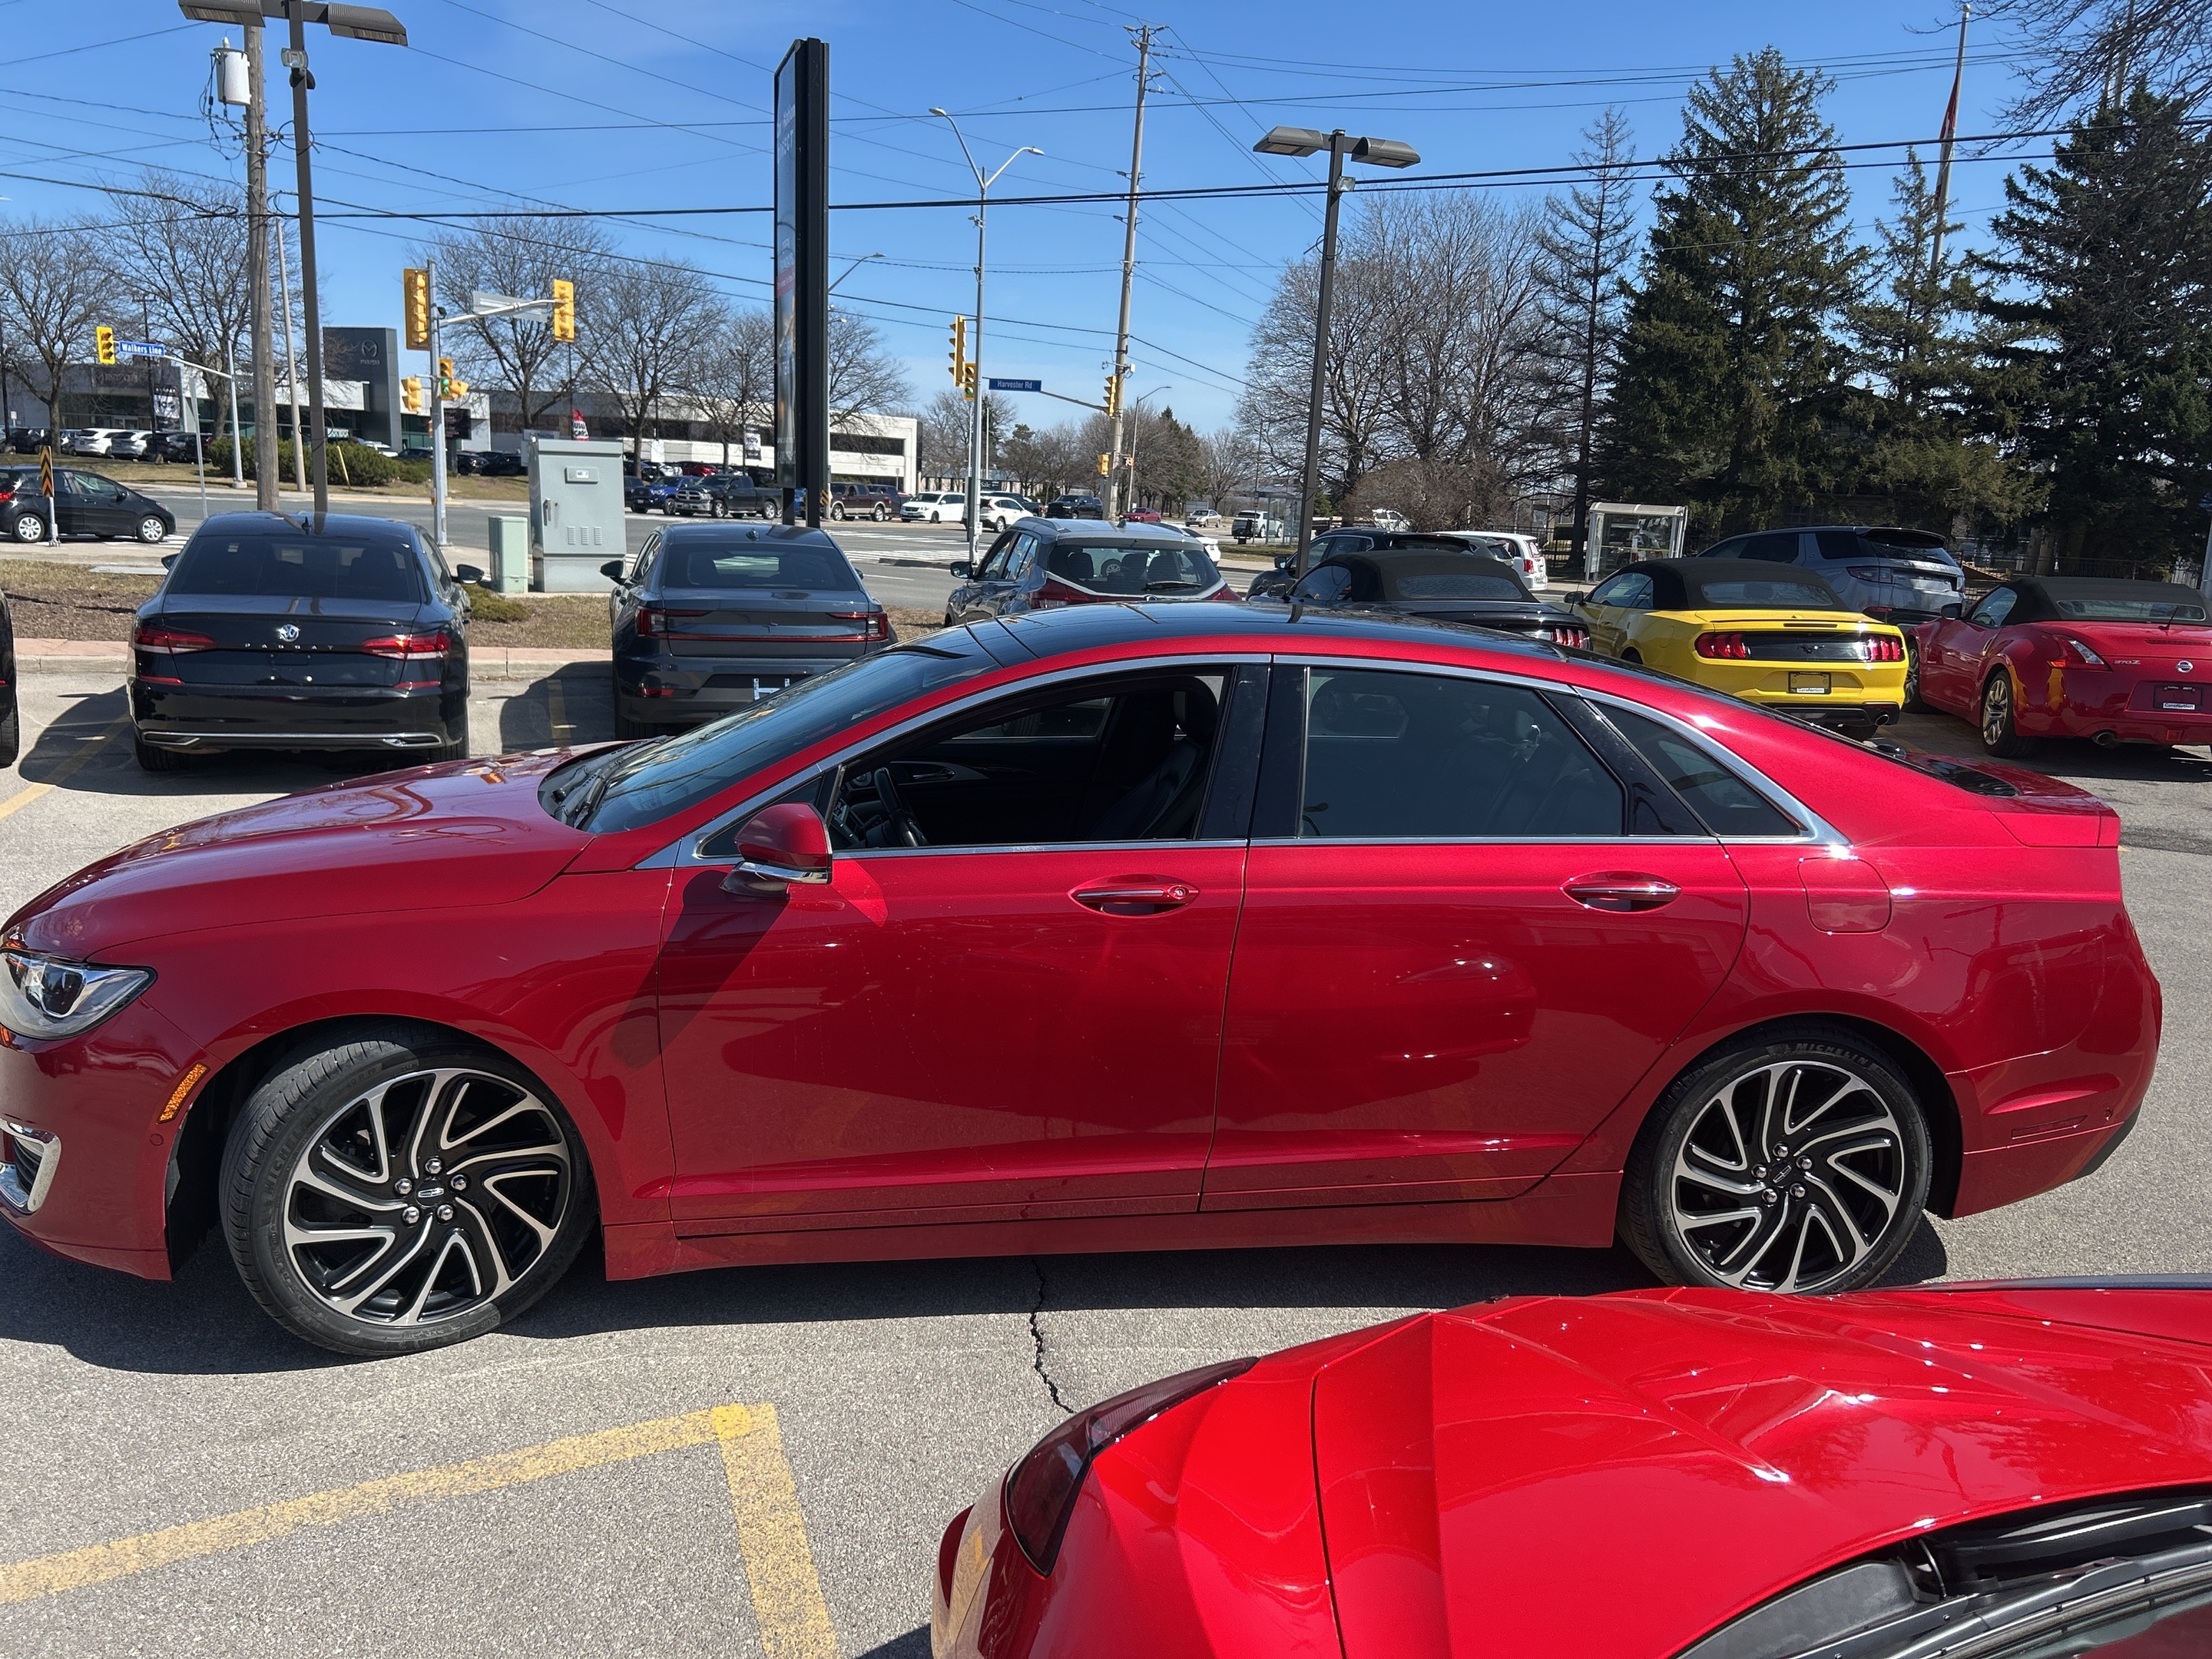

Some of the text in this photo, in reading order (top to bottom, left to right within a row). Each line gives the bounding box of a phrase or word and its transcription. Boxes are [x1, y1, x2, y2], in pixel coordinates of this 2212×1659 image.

[121, 343, 162, 355] Walkers Line
[997, 379, 1033, 389] Harvester Rd
[245, 642, 333, 651] PASSAT
[1795, 1042, 1869, 1065] MICHELIN
[263, 1106, 323, 1196] MICHELIN
